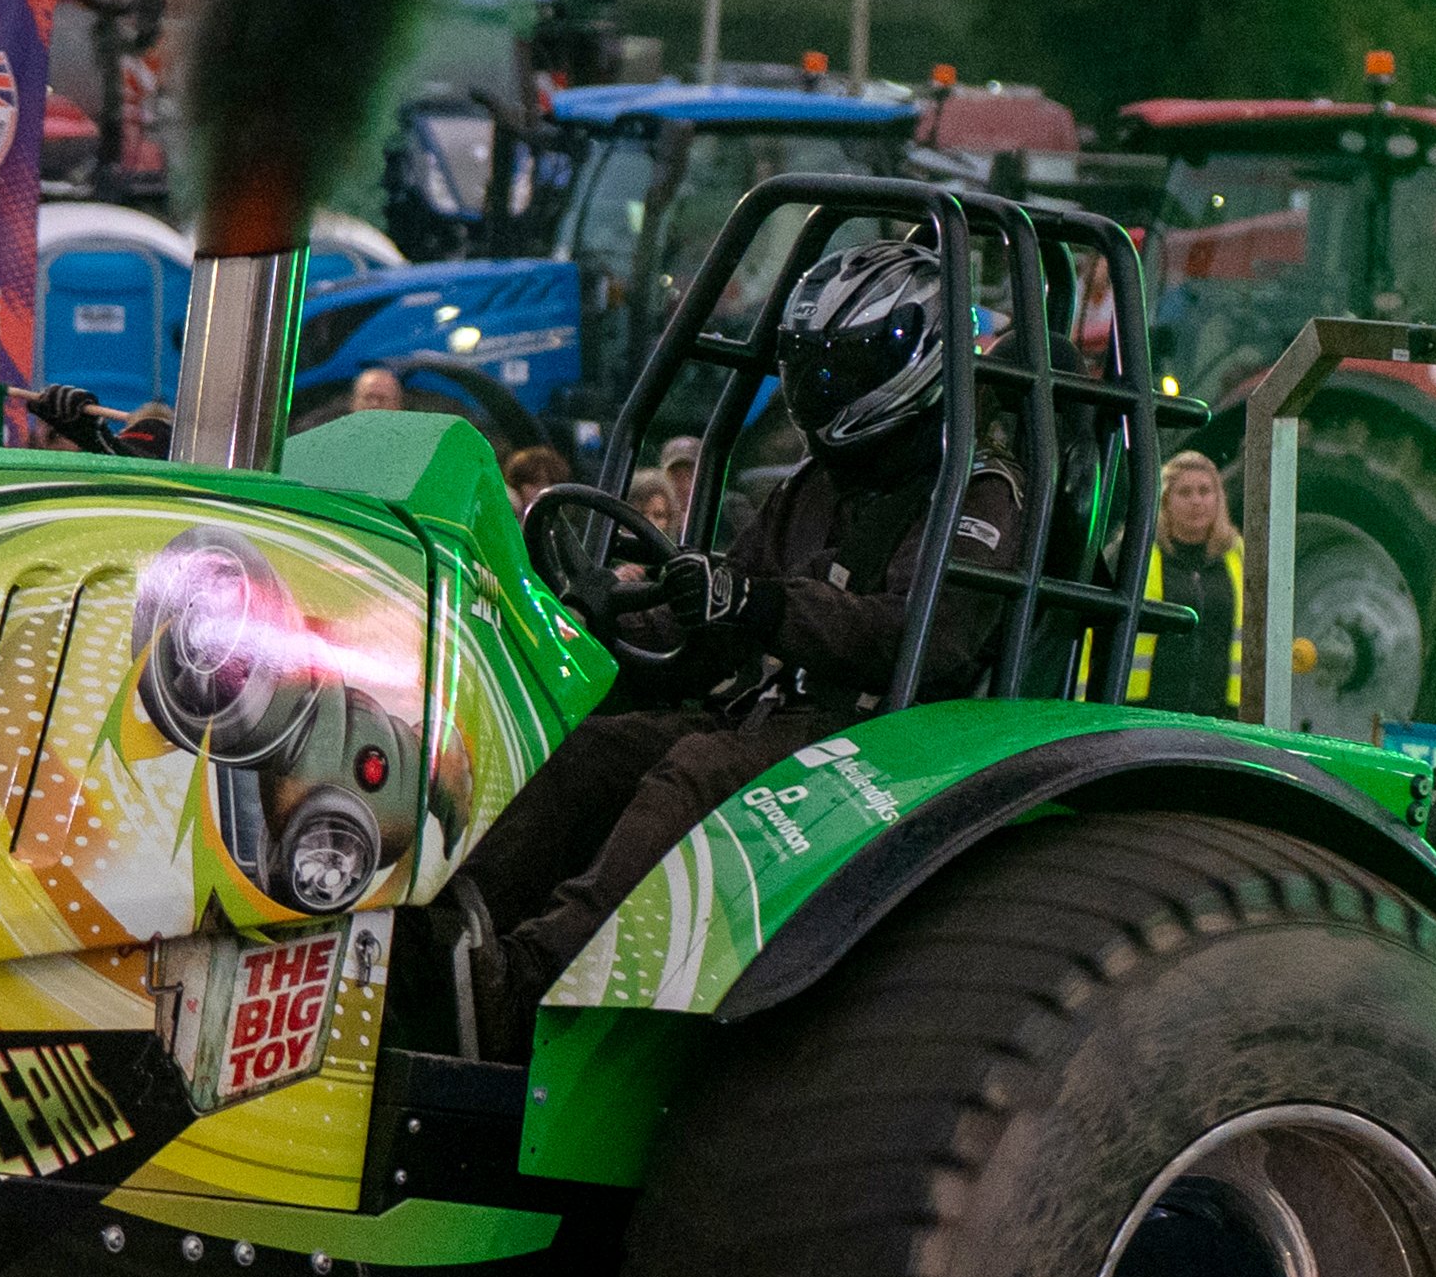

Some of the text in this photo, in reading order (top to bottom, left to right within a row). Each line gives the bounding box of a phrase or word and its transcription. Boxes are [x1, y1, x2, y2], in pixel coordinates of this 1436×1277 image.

[243, 938, 337, 998] THE
[231, 984, 326, 1051] BIG
[228, 1030, 316, 1088] TOY
